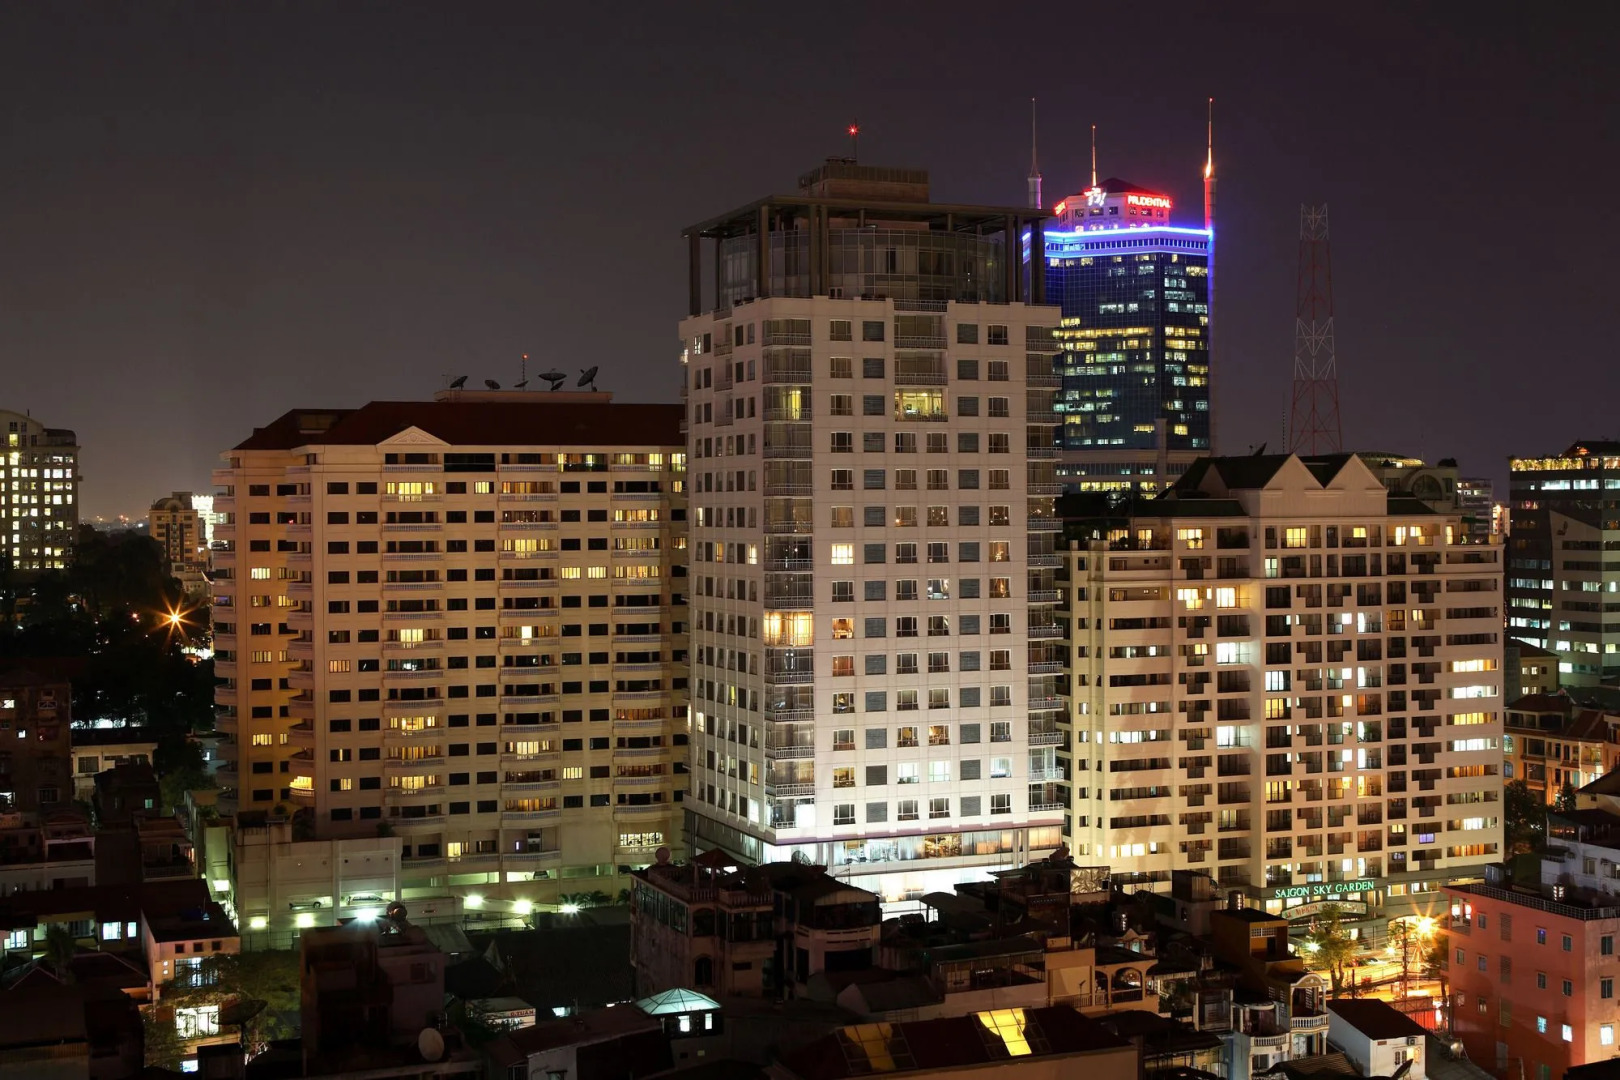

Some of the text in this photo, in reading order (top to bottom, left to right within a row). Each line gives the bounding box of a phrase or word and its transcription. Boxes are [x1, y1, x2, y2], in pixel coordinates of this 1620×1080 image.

[1127, 194, 1171, 208] PRUDENTIAL
[1275, 881, 1374, 898] SAIGON SKY GARDEN
